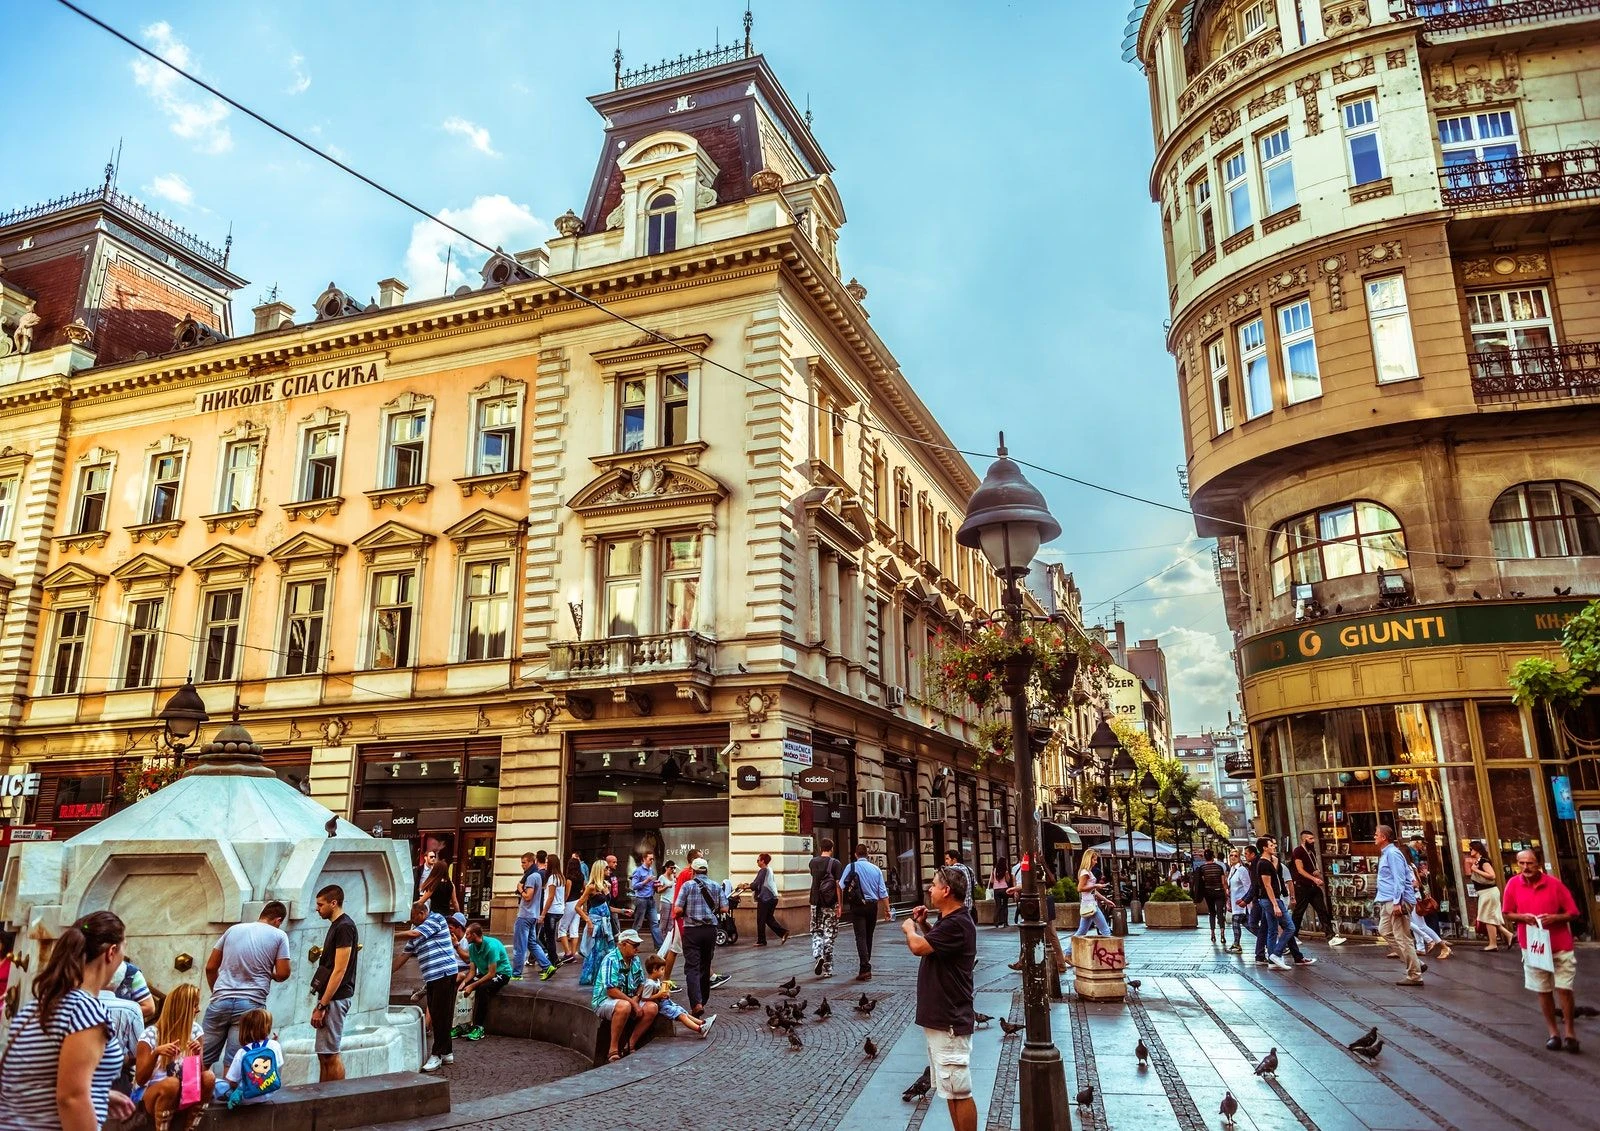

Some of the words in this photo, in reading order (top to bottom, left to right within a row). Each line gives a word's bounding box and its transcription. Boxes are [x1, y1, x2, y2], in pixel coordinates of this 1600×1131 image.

[201, 382, 275, 412] НИКОЛЕ
[282, 363, 379, 397] СПАСИЋА
[1339, 616, 1445, 647] GIUNTI
[1115, 705, 1136, 713] TOP
[0, 773, 40, 796] ICE
[60, 803, 105, 818] REPLAY
[633, 809, 659, 818] adidas
[392, 816, 414, 825] adidas
[463, 813, 494, 824] adidas
[259, 1071, 277, 1091] WOW!
